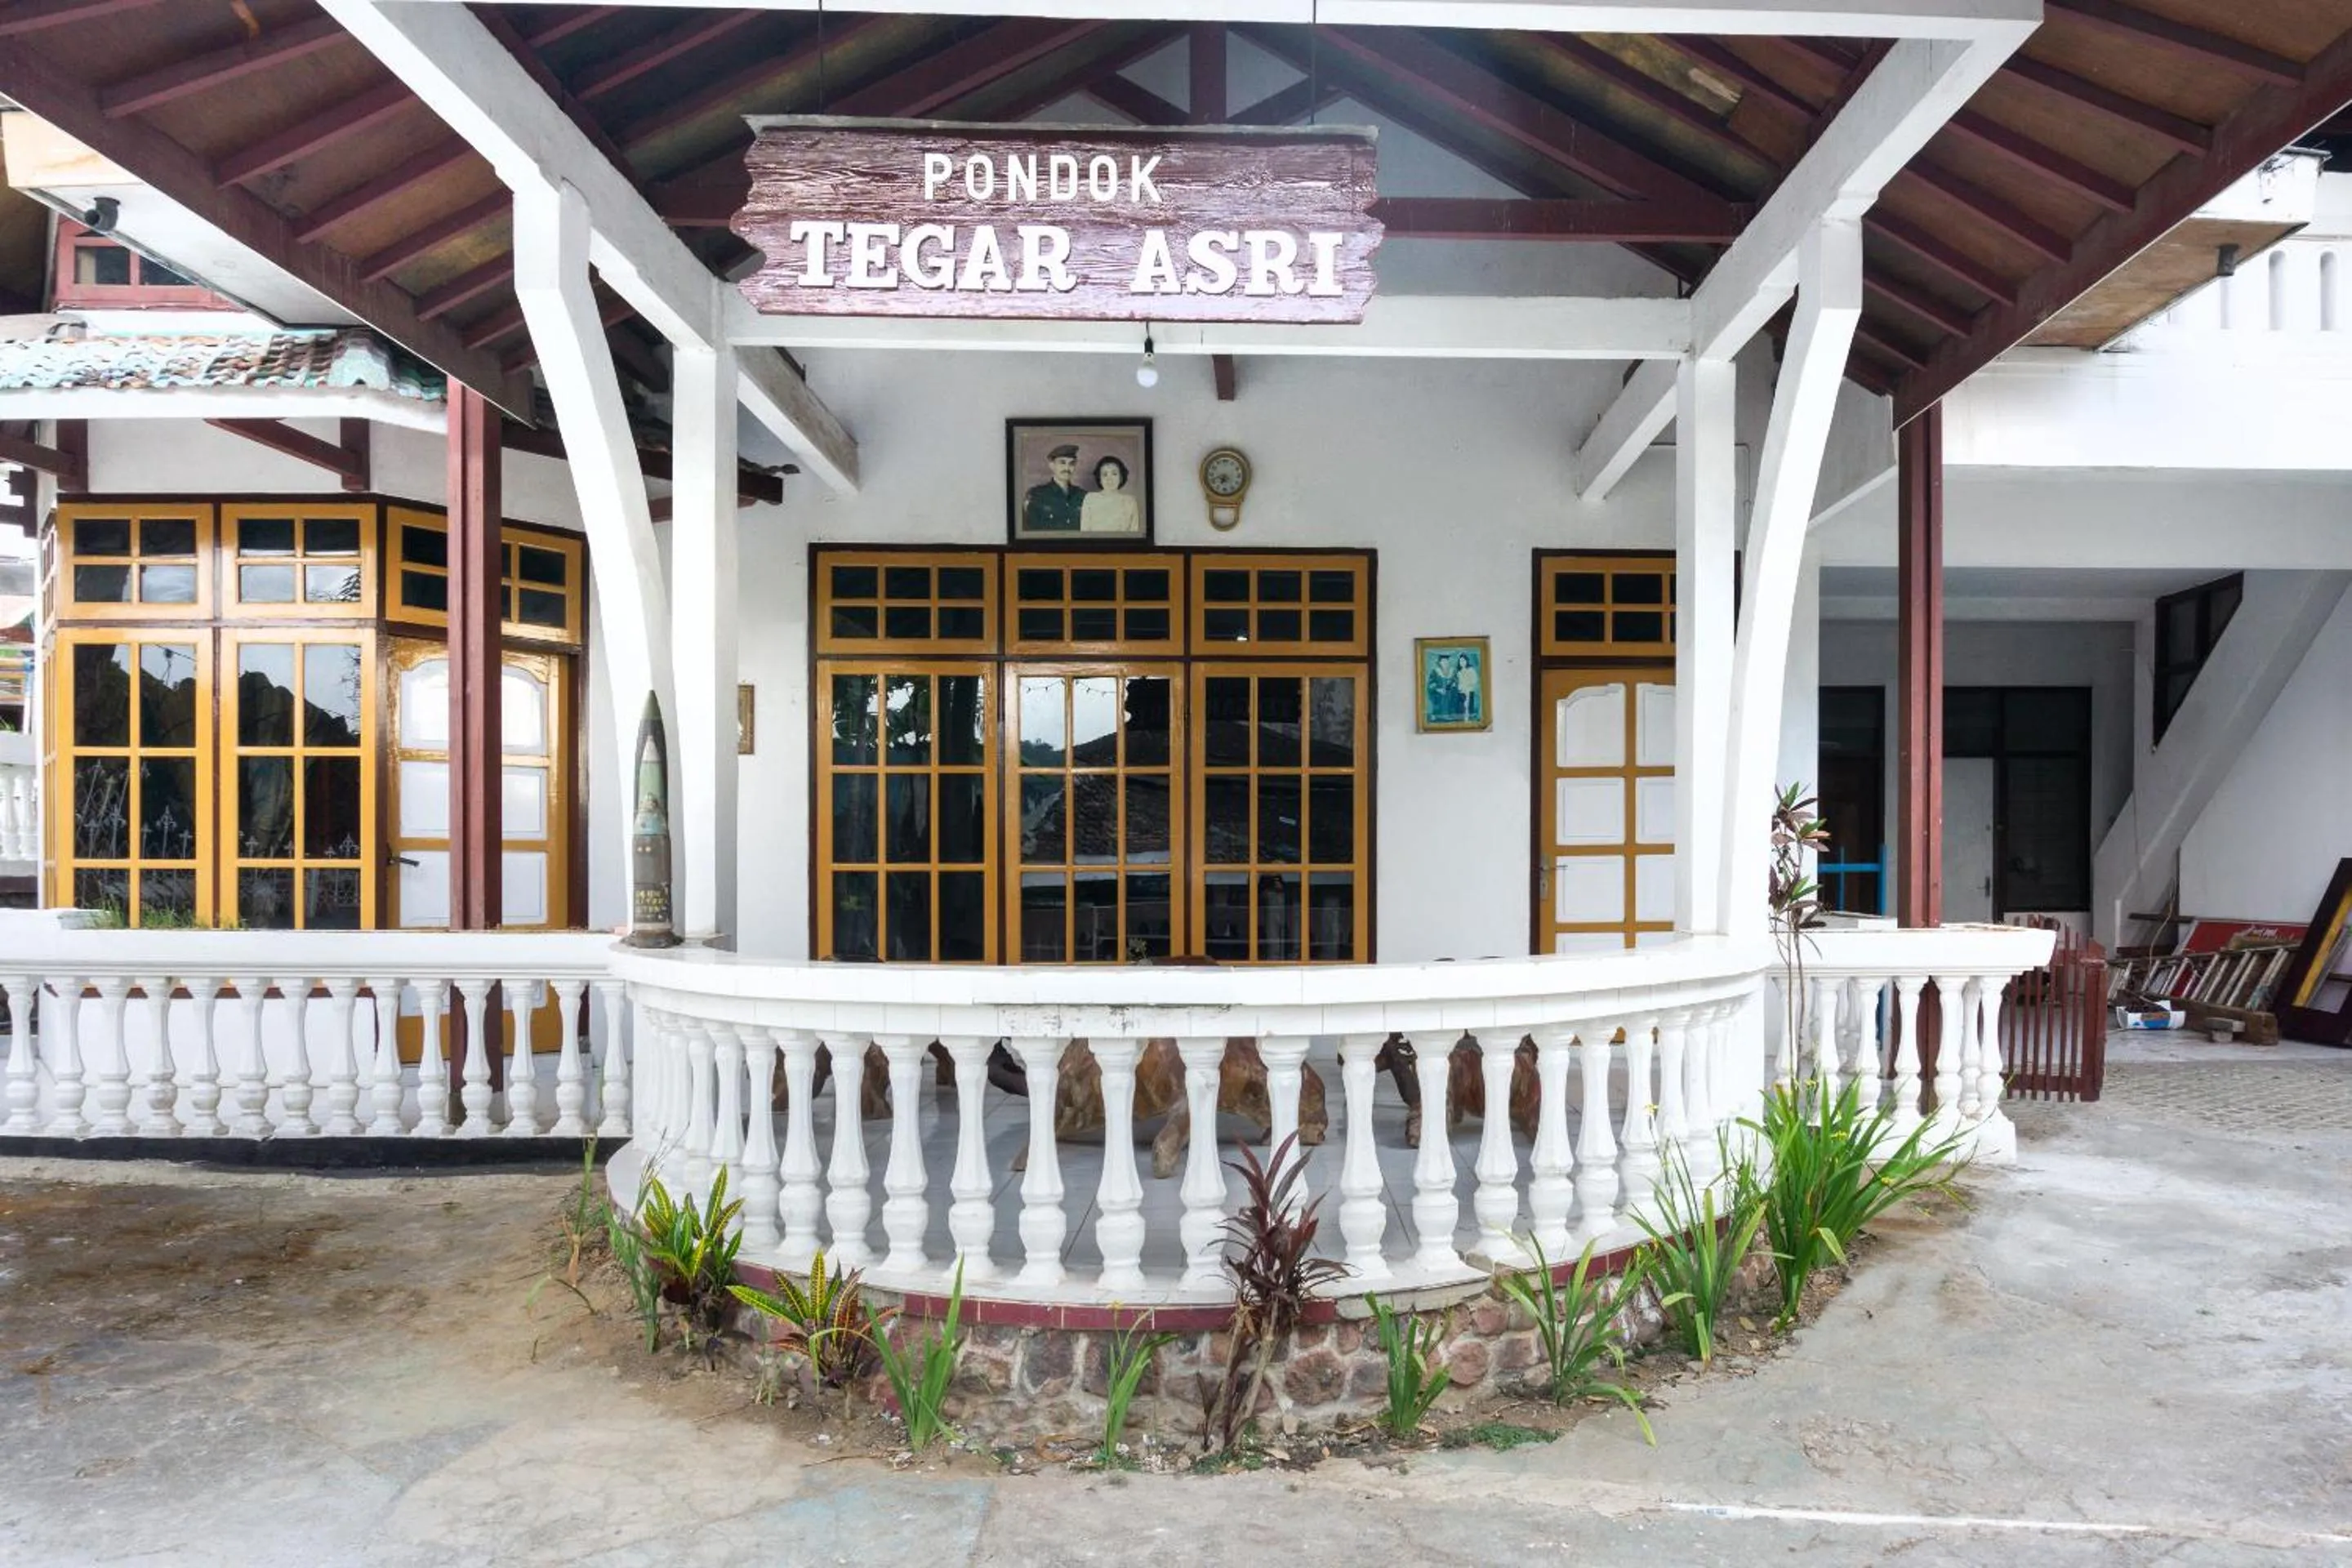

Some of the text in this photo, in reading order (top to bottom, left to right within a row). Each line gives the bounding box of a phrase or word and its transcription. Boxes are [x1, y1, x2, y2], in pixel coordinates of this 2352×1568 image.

[924, 153, 1163, 203] PONDOK
[791, 220, 1343, 296] TEGAR ASRI
